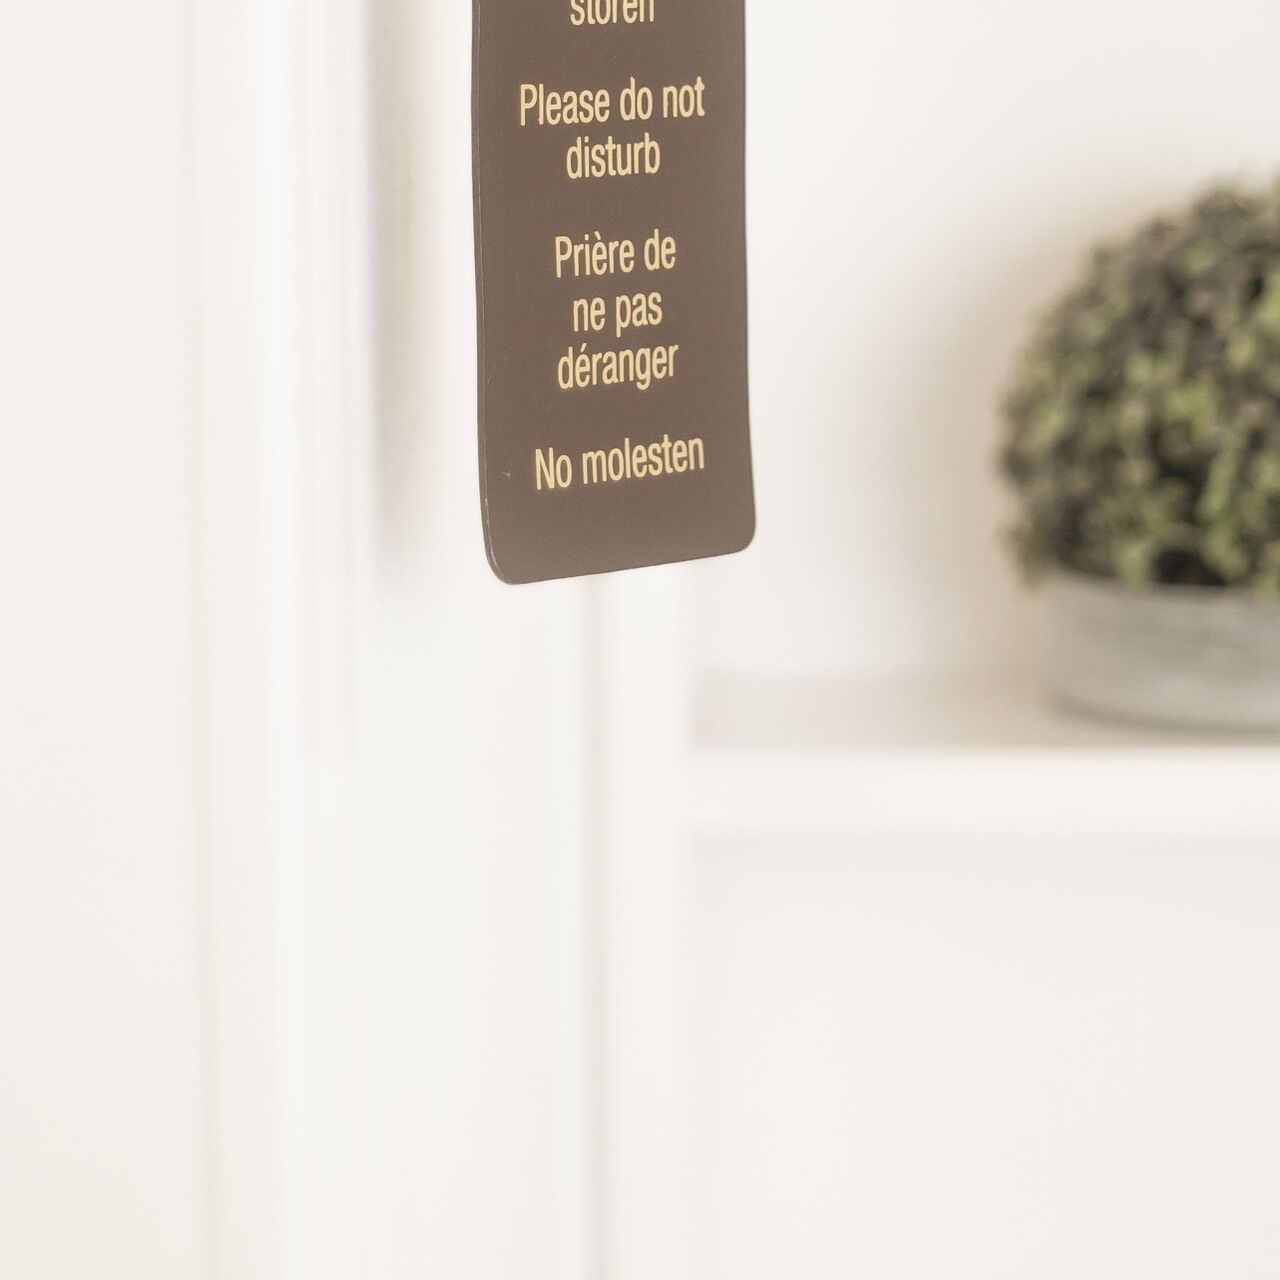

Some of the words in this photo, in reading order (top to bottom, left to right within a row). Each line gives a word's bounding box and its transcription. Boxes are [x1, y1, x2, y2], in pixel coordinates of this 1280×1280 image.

[519, 82, 611, 127] Please
[619, 75, 654, 122] do
[662, 75, 706, 119] not
[565, 131, 661, 180] disturb
[554, 230, 636, 279] Prière
[643, 227, 677, 272] de
[572, 296, 606, 333] ne
[615, 291, 663, 339] pas
[557, 342, 680, 392] déranger
[533, 446, 573, 493] No
[581, 433, 705, 485] molesten
